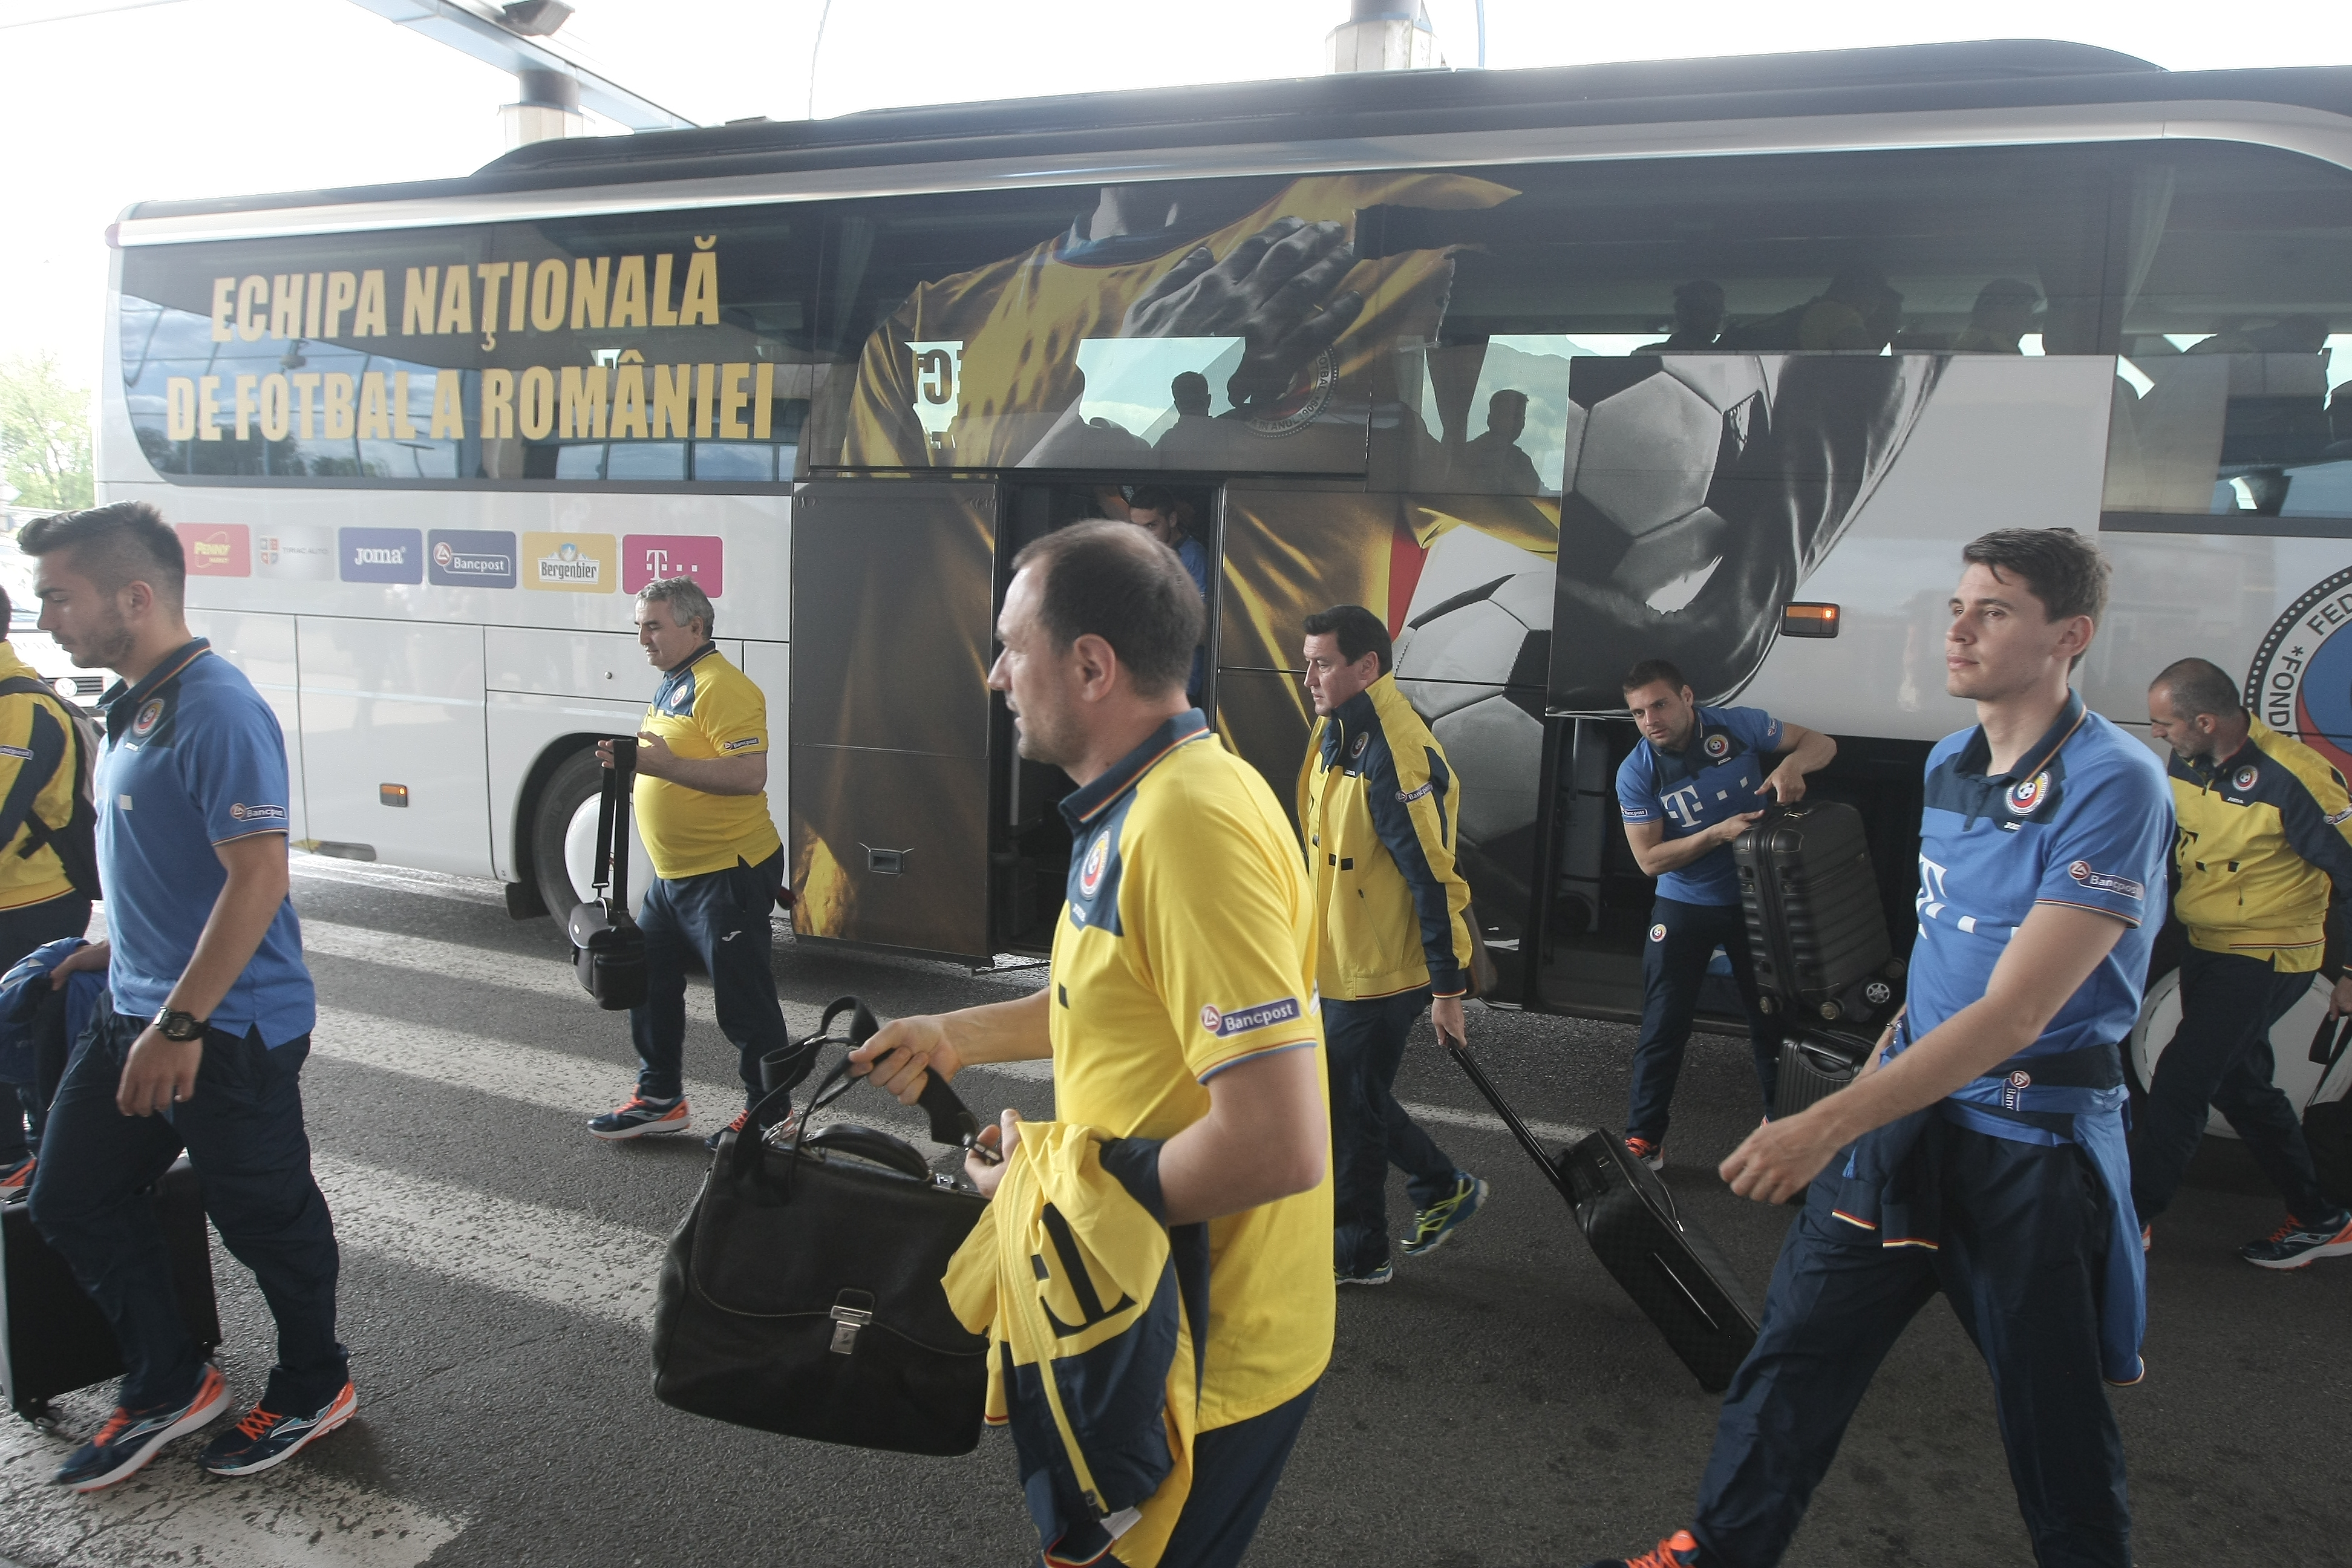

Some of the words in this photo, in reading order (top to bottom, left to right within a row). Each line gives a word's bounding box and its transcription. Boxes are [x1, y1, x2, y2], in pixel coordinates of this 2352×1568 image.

[211, 272, 387, 342] ECHIPA
[166, 374, 221, 441] DE
[236, 369, 416, 442] FOTBAL
[431, 369, 465, 440] A
[481, 349, 773, 441] ROMÂNIEI
[453, 557, 505, 572] Bancpost
[541, 562, 597, 580] Bergenbier
[2269, 656, 2304, 737] FOND
[2089, 875, 2137, 894] Bancpos
[1225, 1003, 1293, 1031] Bancpost
